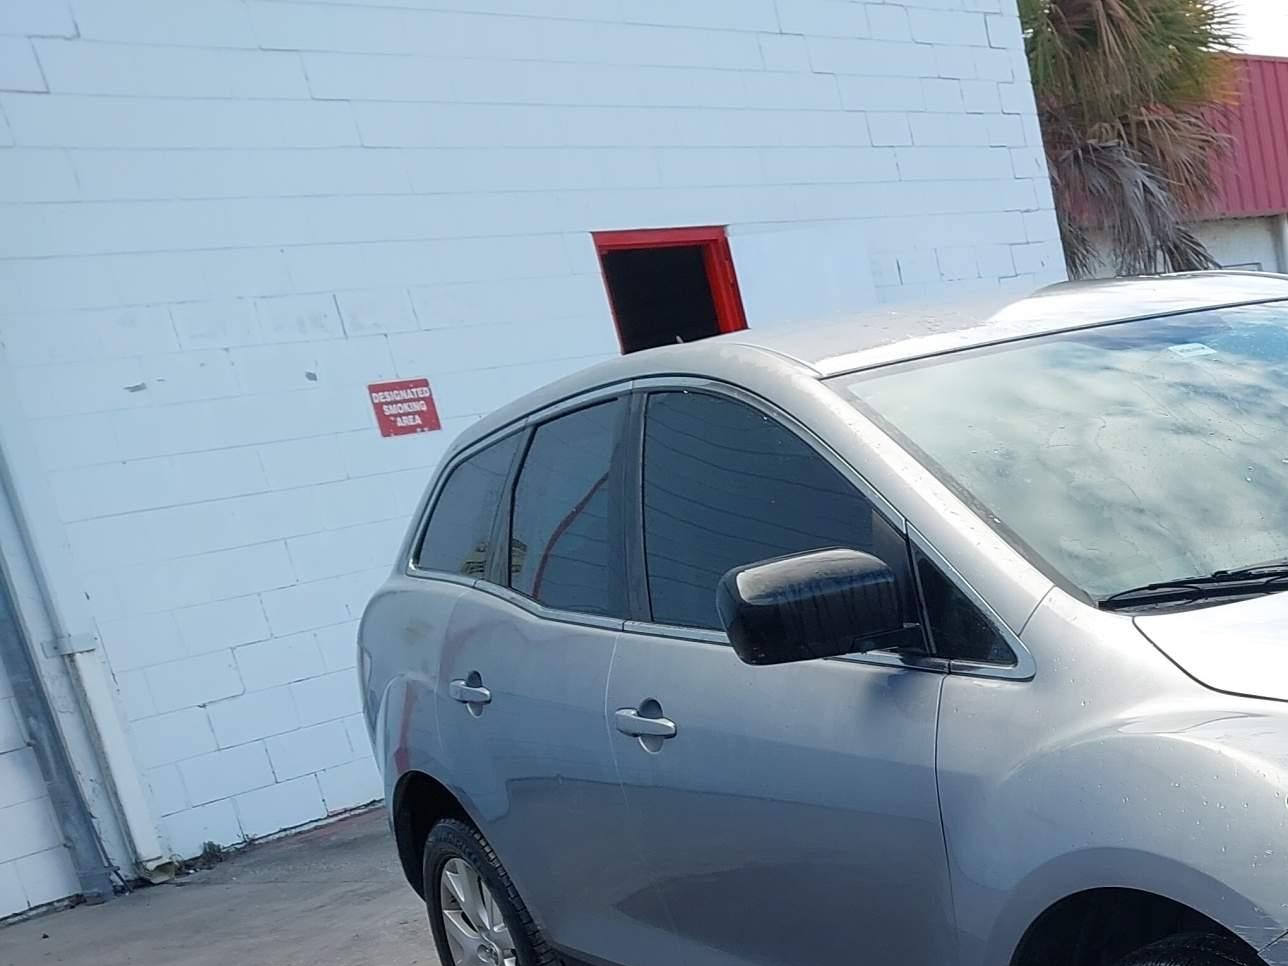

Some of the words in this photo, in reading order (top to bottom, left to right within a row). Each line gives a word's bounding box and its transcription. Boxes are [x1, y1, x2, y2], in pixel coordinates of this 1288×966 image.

[372, 388, 430, 402] DESIGNATED
[383, 401, 427, 415] SMOKING
[396, 415, 422, 426] AREA
